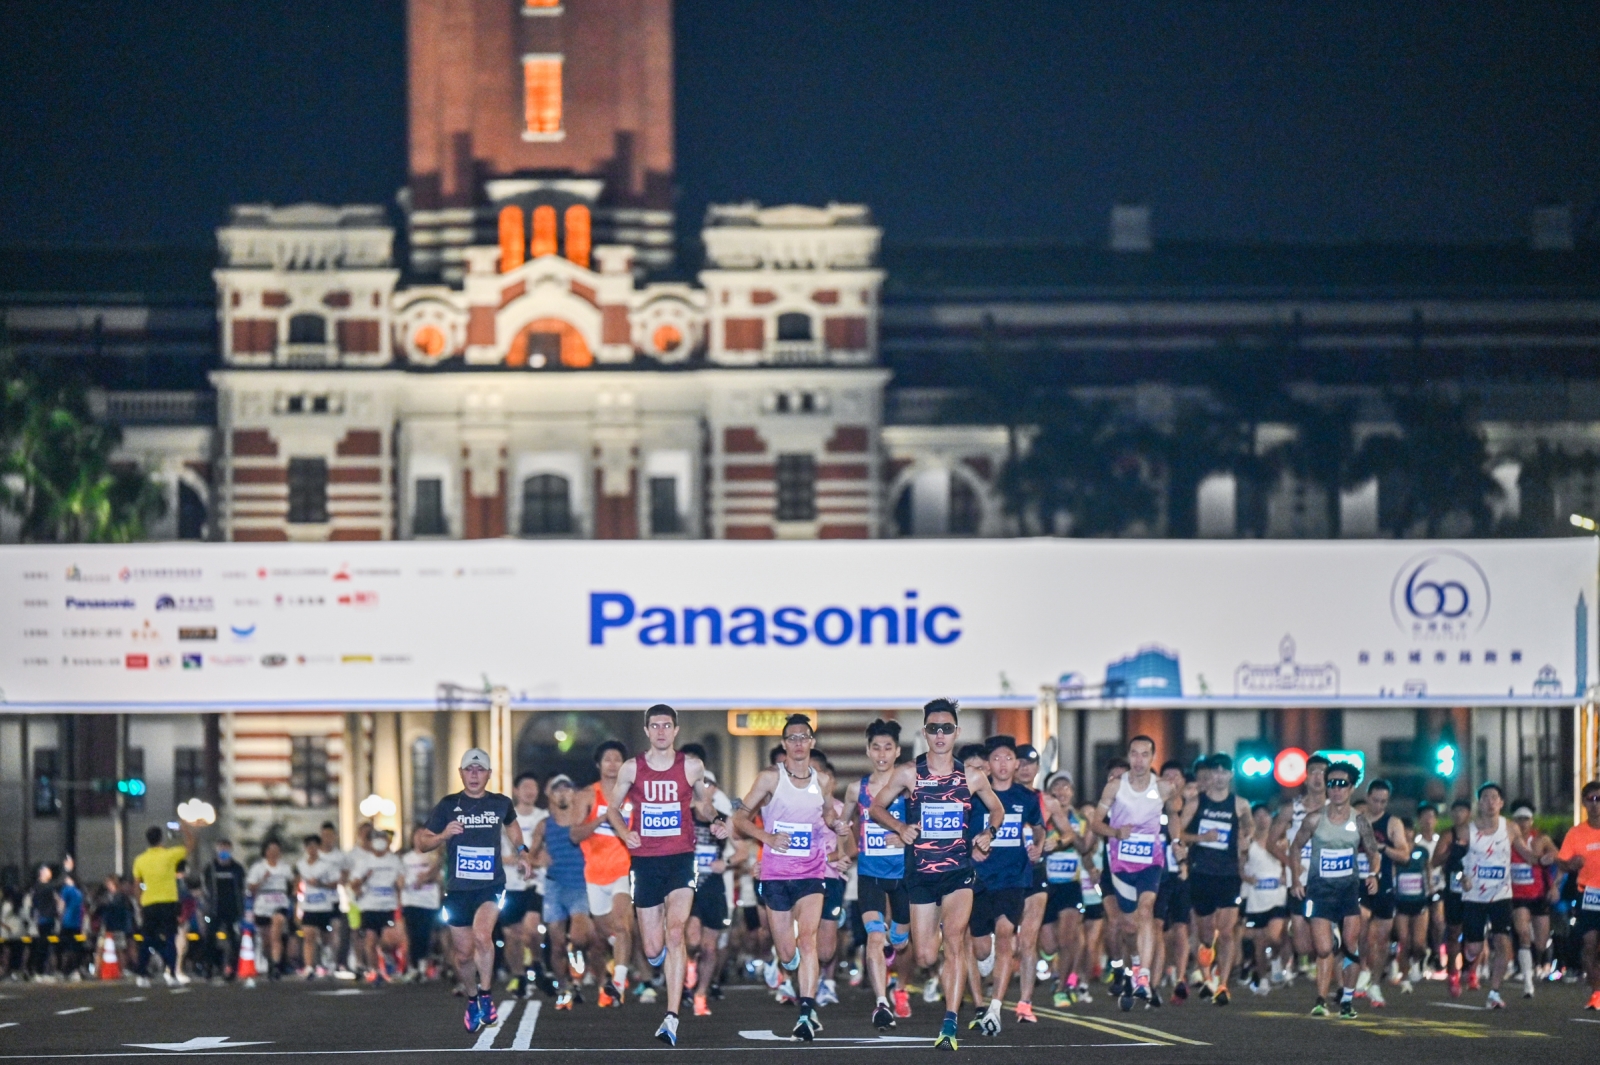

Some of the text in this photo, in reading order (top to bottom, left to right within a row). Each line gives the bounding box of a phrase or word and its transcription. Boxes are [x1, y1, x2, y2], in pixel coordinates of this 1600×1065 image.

[66, 596, 136, 610] Panasonic
[589, 590, 962, 646] Panasonic
[643, 780, 678, 802] UTR
[457, 814, 500, 825] finisher
[644, 816, 679, 828] 0606
[925, 816, 961, 829] 1526
[1121, 843, 1152, 856] 2535
[459, 858, 492, 871] 2530
[1322, 859, 1351, 870] 2511
